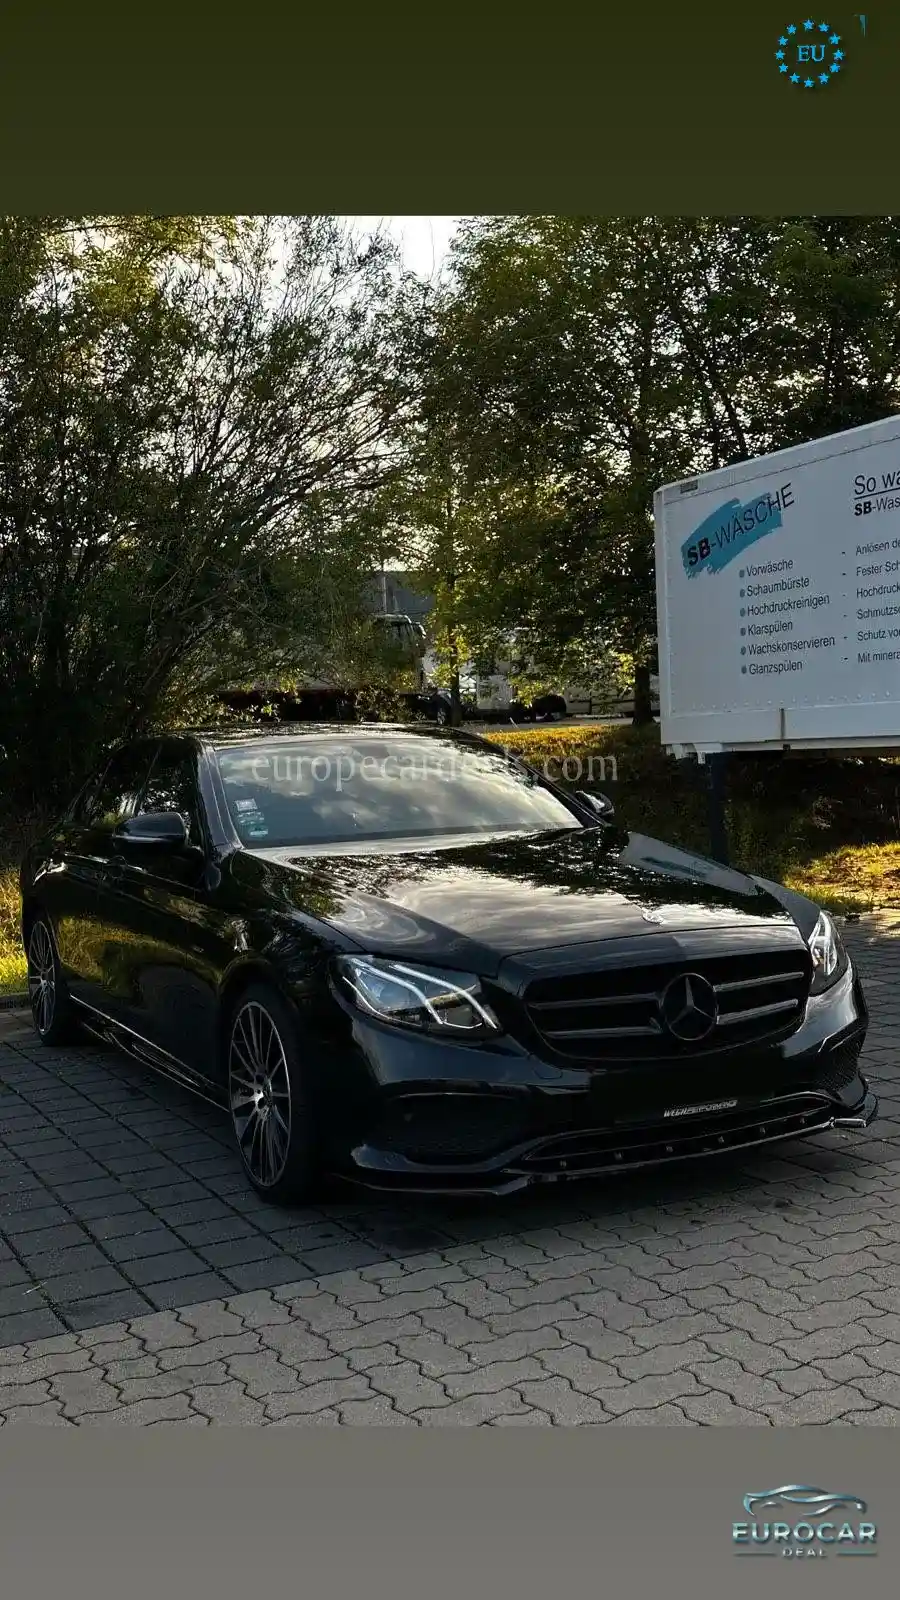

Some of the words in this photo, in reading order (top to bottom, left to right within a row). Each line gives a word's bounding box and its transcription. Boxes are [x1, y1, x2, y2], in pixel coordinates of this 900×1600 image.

[854, 474, 877, 496] So
[854, 497, 900, 516] SB-Was
[687, 482, 795, 566] SB-WÄSCHE
[856, 540, 890, 556] Anlösen
[746, 559, 794, 577] Vorwäsche
[856, 565, 882, 577] Fester
[746, 577, 810, 597] Schaumbürste
[747, 594, 830, 617] Hochdruckreinigen
[747, 620, 793, 636] Klarspülen
[857, 629, 886, 641] Schutz
[748, 635, 835, 656] Wachskonservieren
[749, 659, 803, 675] Glanzspülen
[858, 653, 871, 664] Mit
